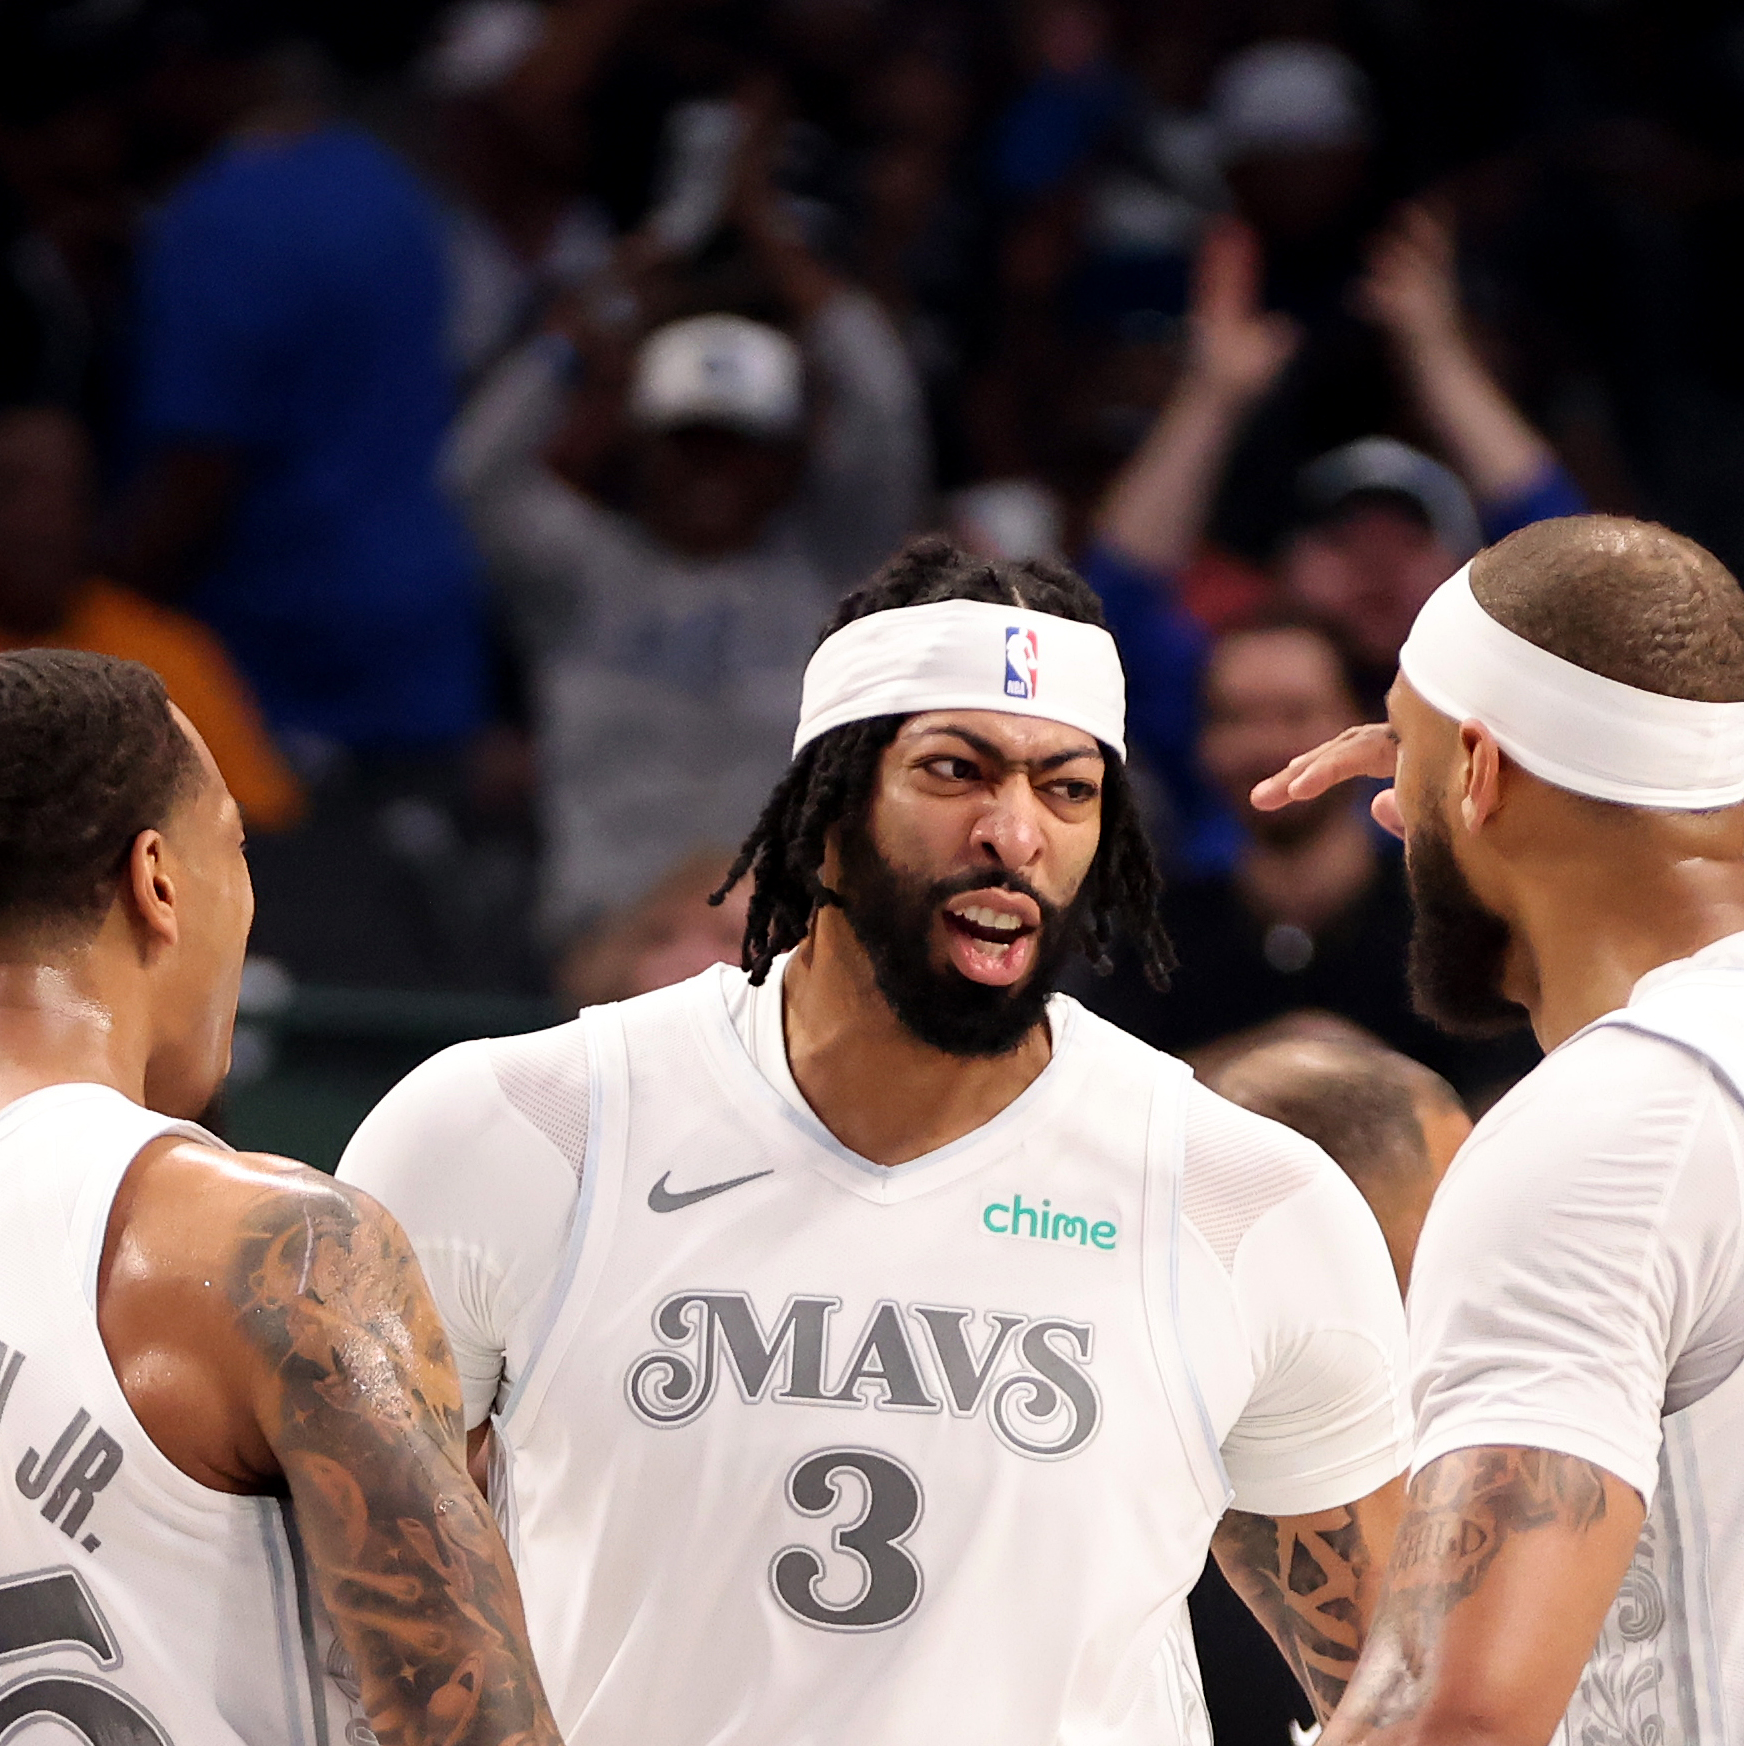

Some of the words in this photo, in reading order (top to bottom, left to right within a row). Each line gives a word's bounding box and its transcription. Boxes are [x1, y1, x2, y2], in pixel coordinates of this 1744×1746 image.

[982, 1194, 1118, 1251] chime
[624, 1290, 1103, 1461] MAVS
[15, 1407, 123, 1553] JR.
[768, 1445, 923, 1633] 3
